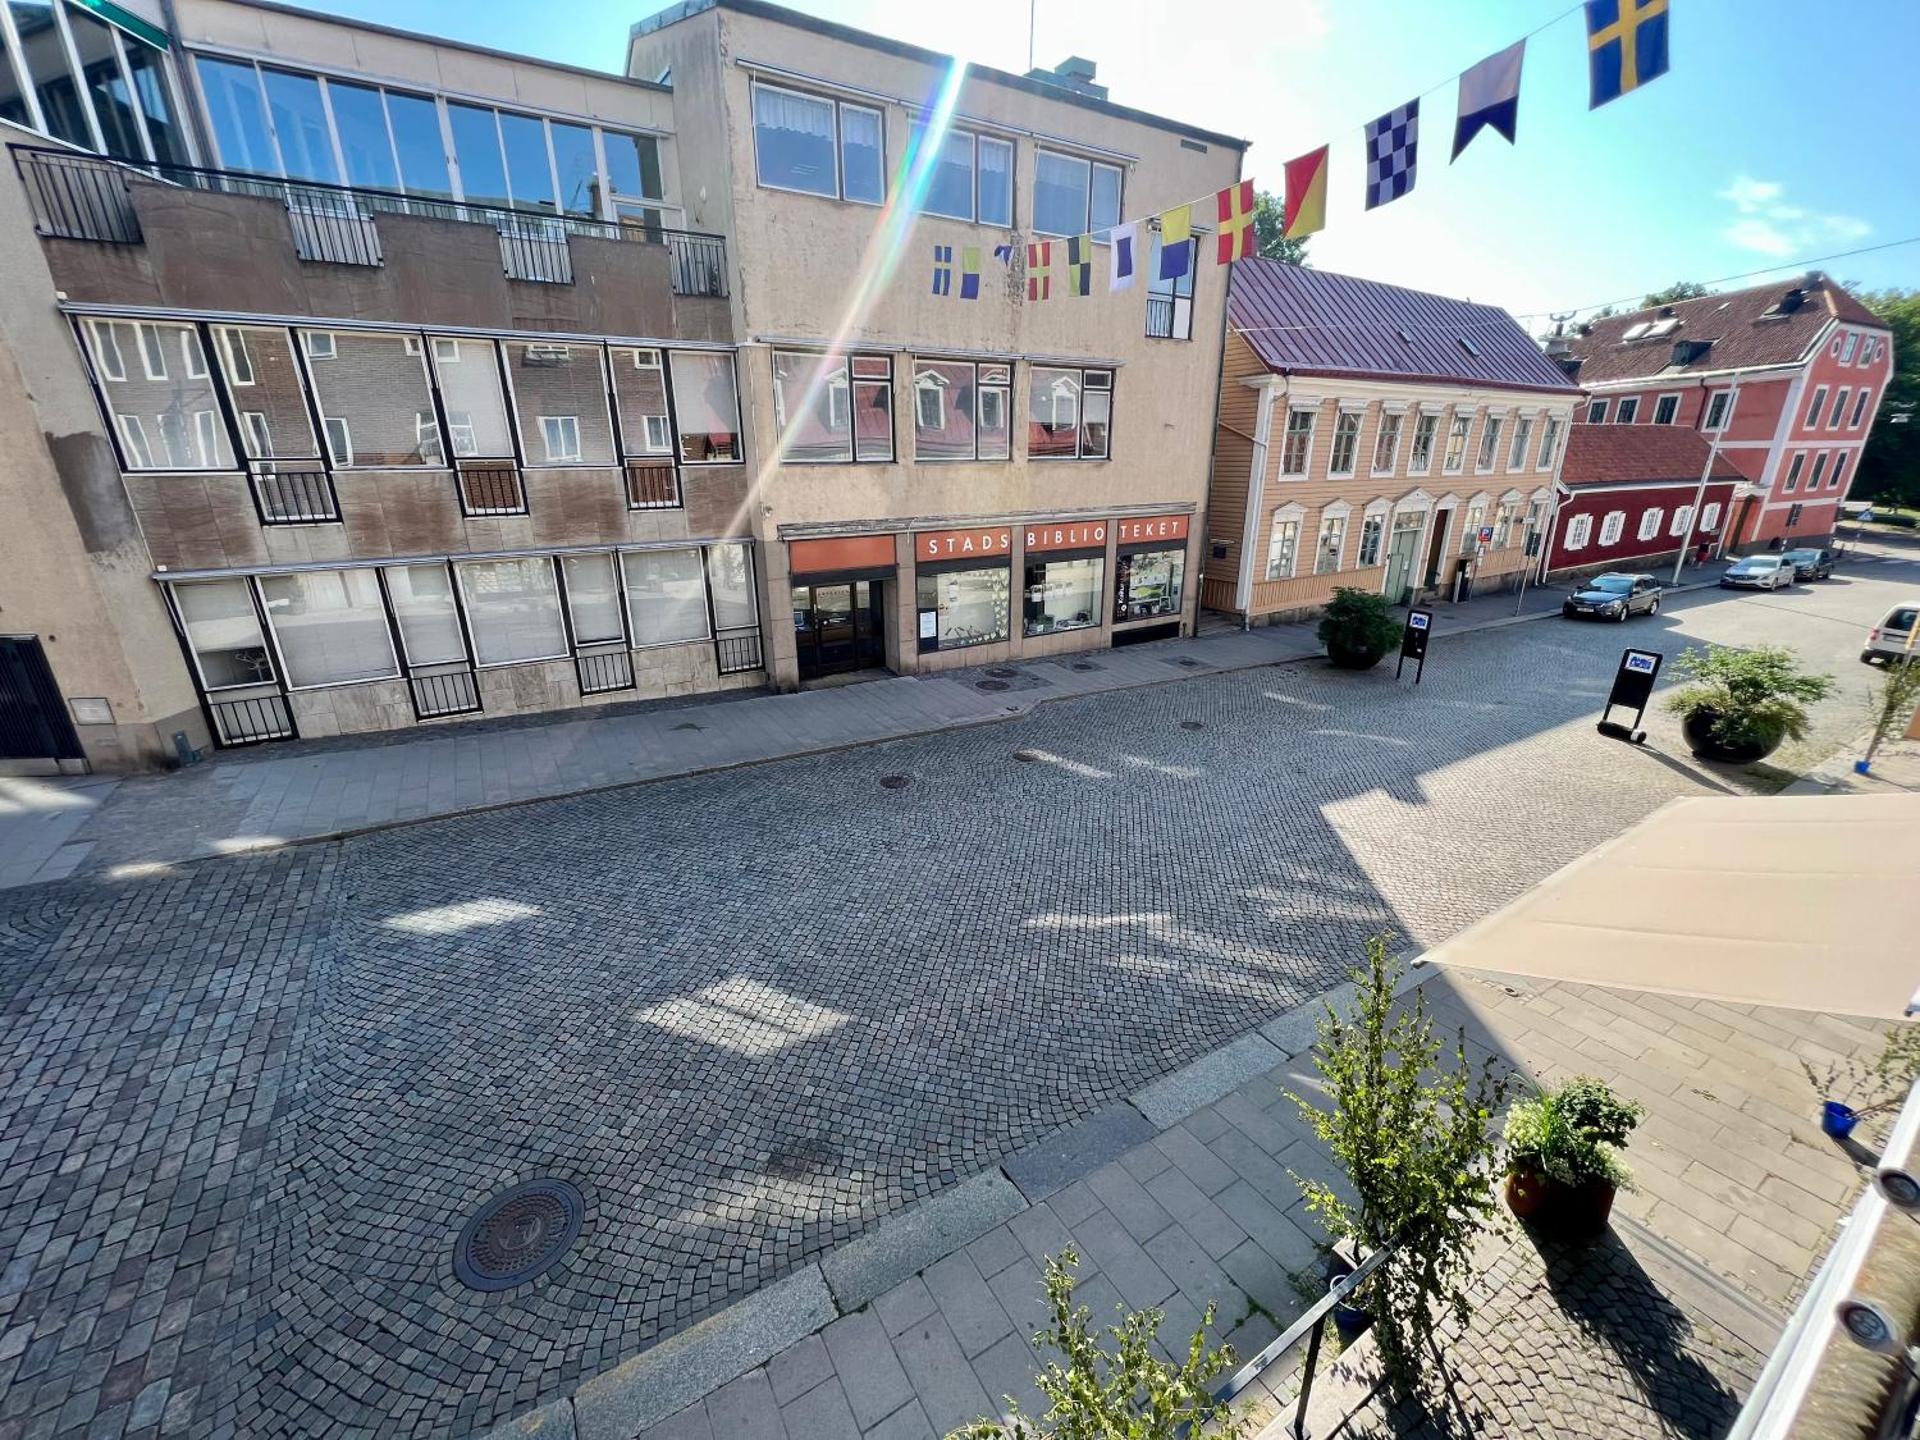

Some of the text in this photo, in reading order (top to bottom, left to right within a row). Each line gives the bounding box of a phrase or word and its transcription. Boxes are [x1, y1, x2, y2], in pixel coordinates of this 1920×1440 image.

[928, 521, 1179, 554] STADS BIBLIO TEKET
